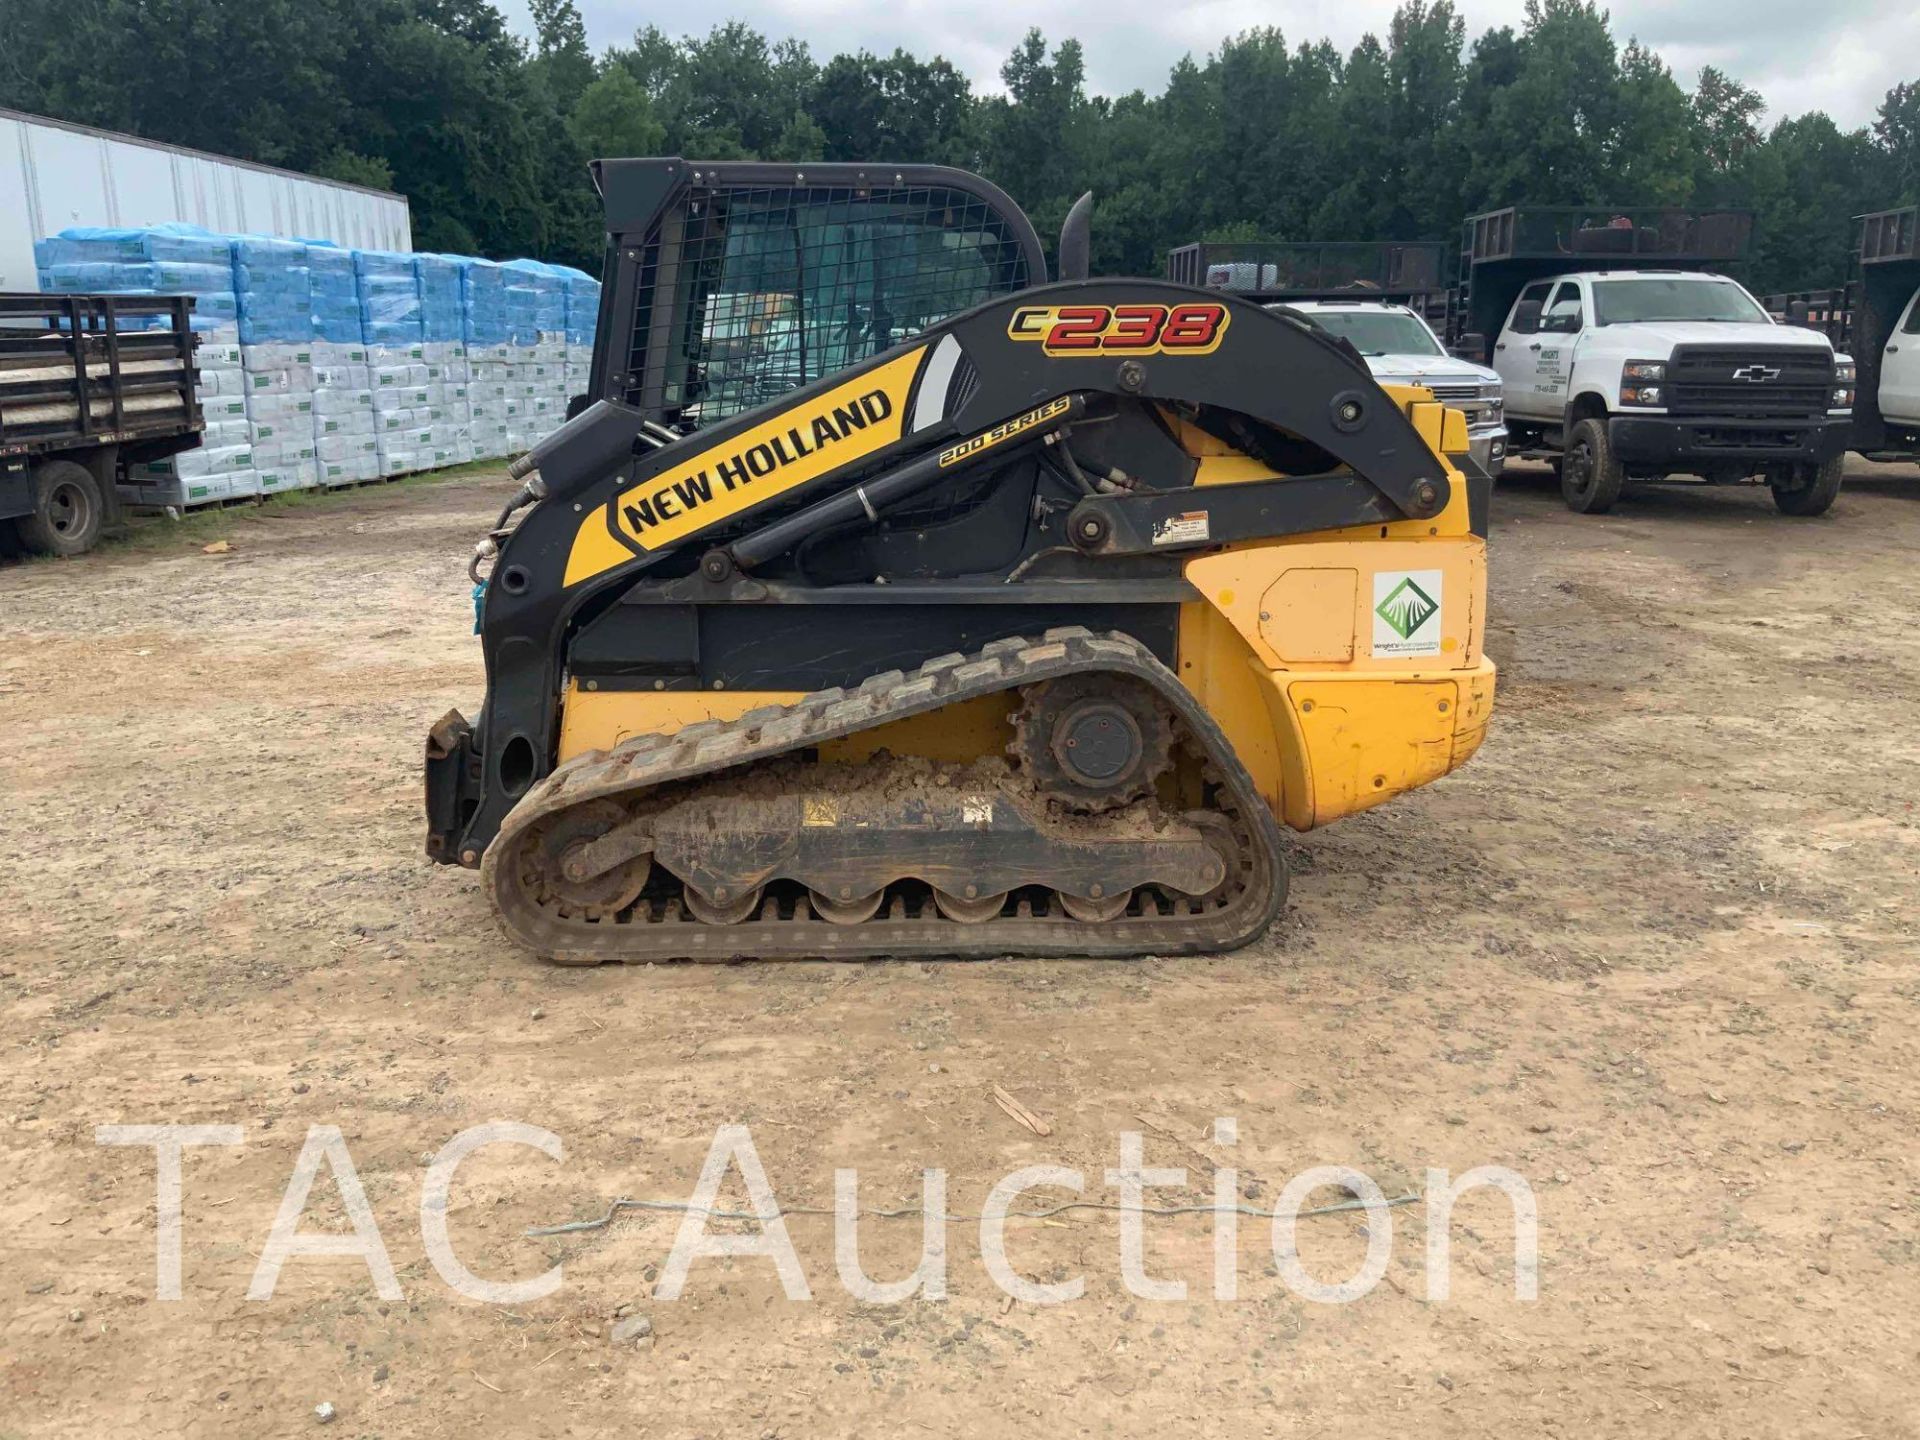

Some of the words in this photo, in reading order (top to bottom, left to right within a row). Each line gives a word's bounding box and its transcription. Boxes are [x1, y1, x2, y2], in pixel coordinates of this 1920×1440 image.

[1010, 305, 1226, 349] C238
[622, 470, 714, 534] NEW
[715, 389, 892, 492] HOLLAND
[940, 435, 985, 465] 200
[989, 397, 1068, 441] SERIES
